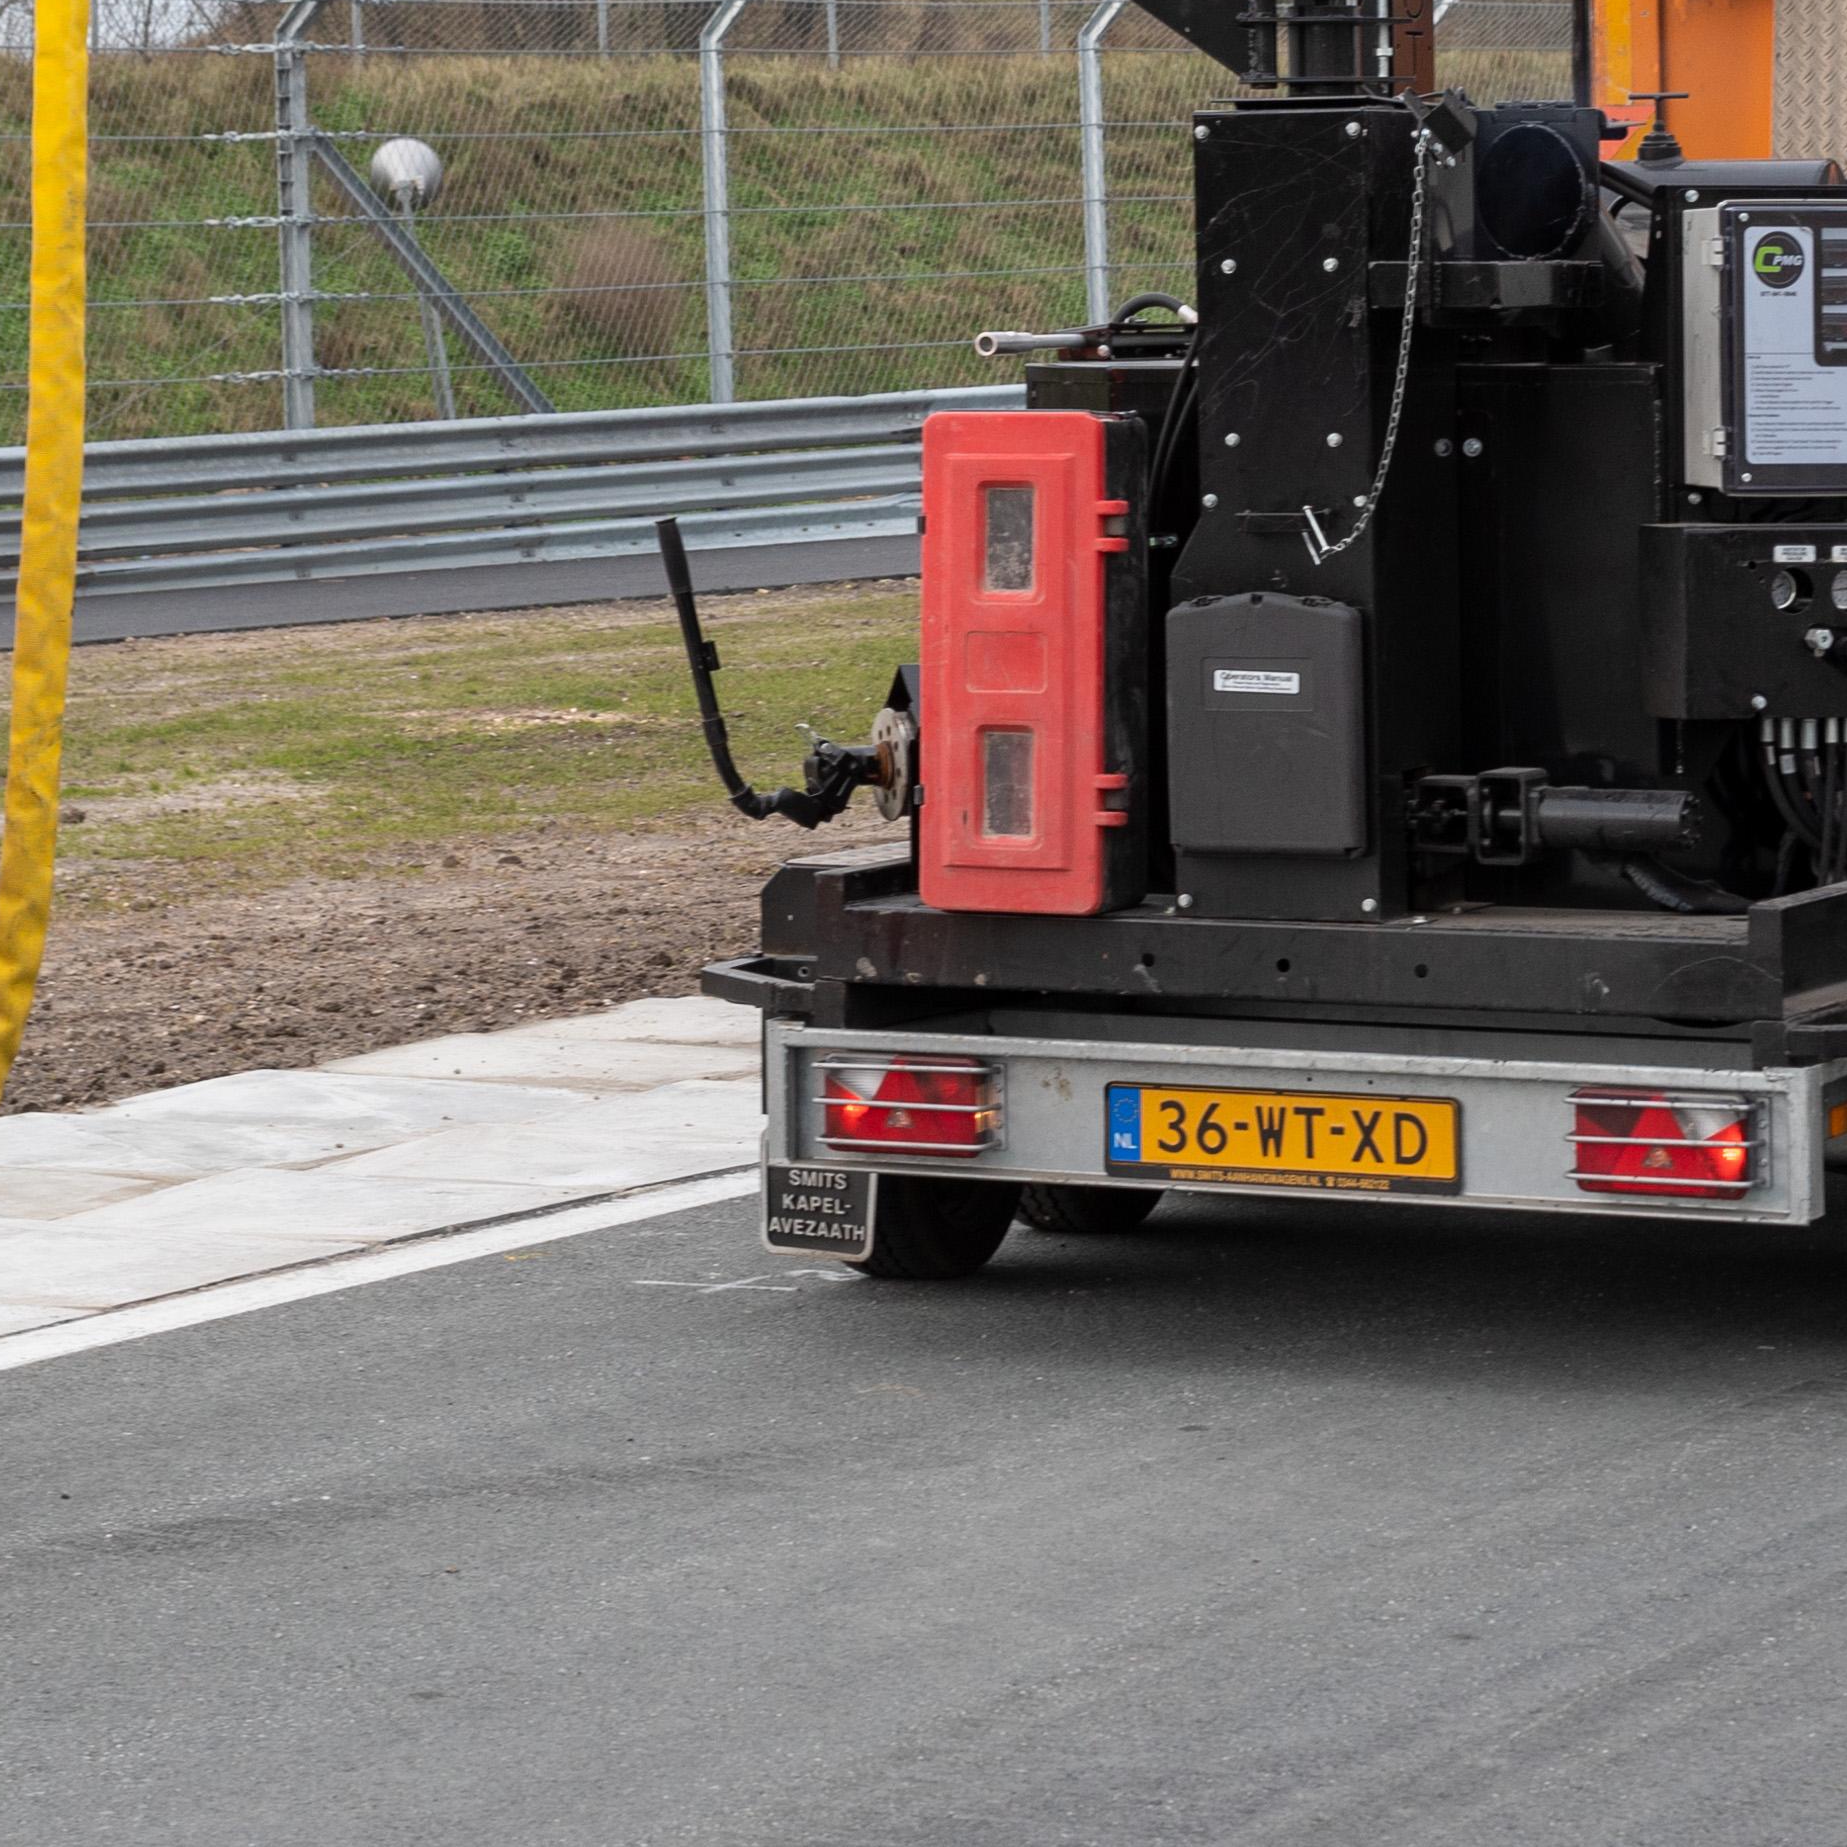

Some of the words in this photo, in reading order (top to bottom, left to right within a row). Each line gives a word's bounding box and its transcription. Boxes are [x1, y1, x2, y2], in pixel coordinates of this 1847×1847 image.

[1113, 1132, 1138, 1150] NL
[1157, 1099, 1429, 1165] 36-WT-XD
[788, 1169, 848, 1190] SMITS
[781, 1193, 852, 1215] KAPEL-
[768, 1216, 866, 1241] AVEZAATH
